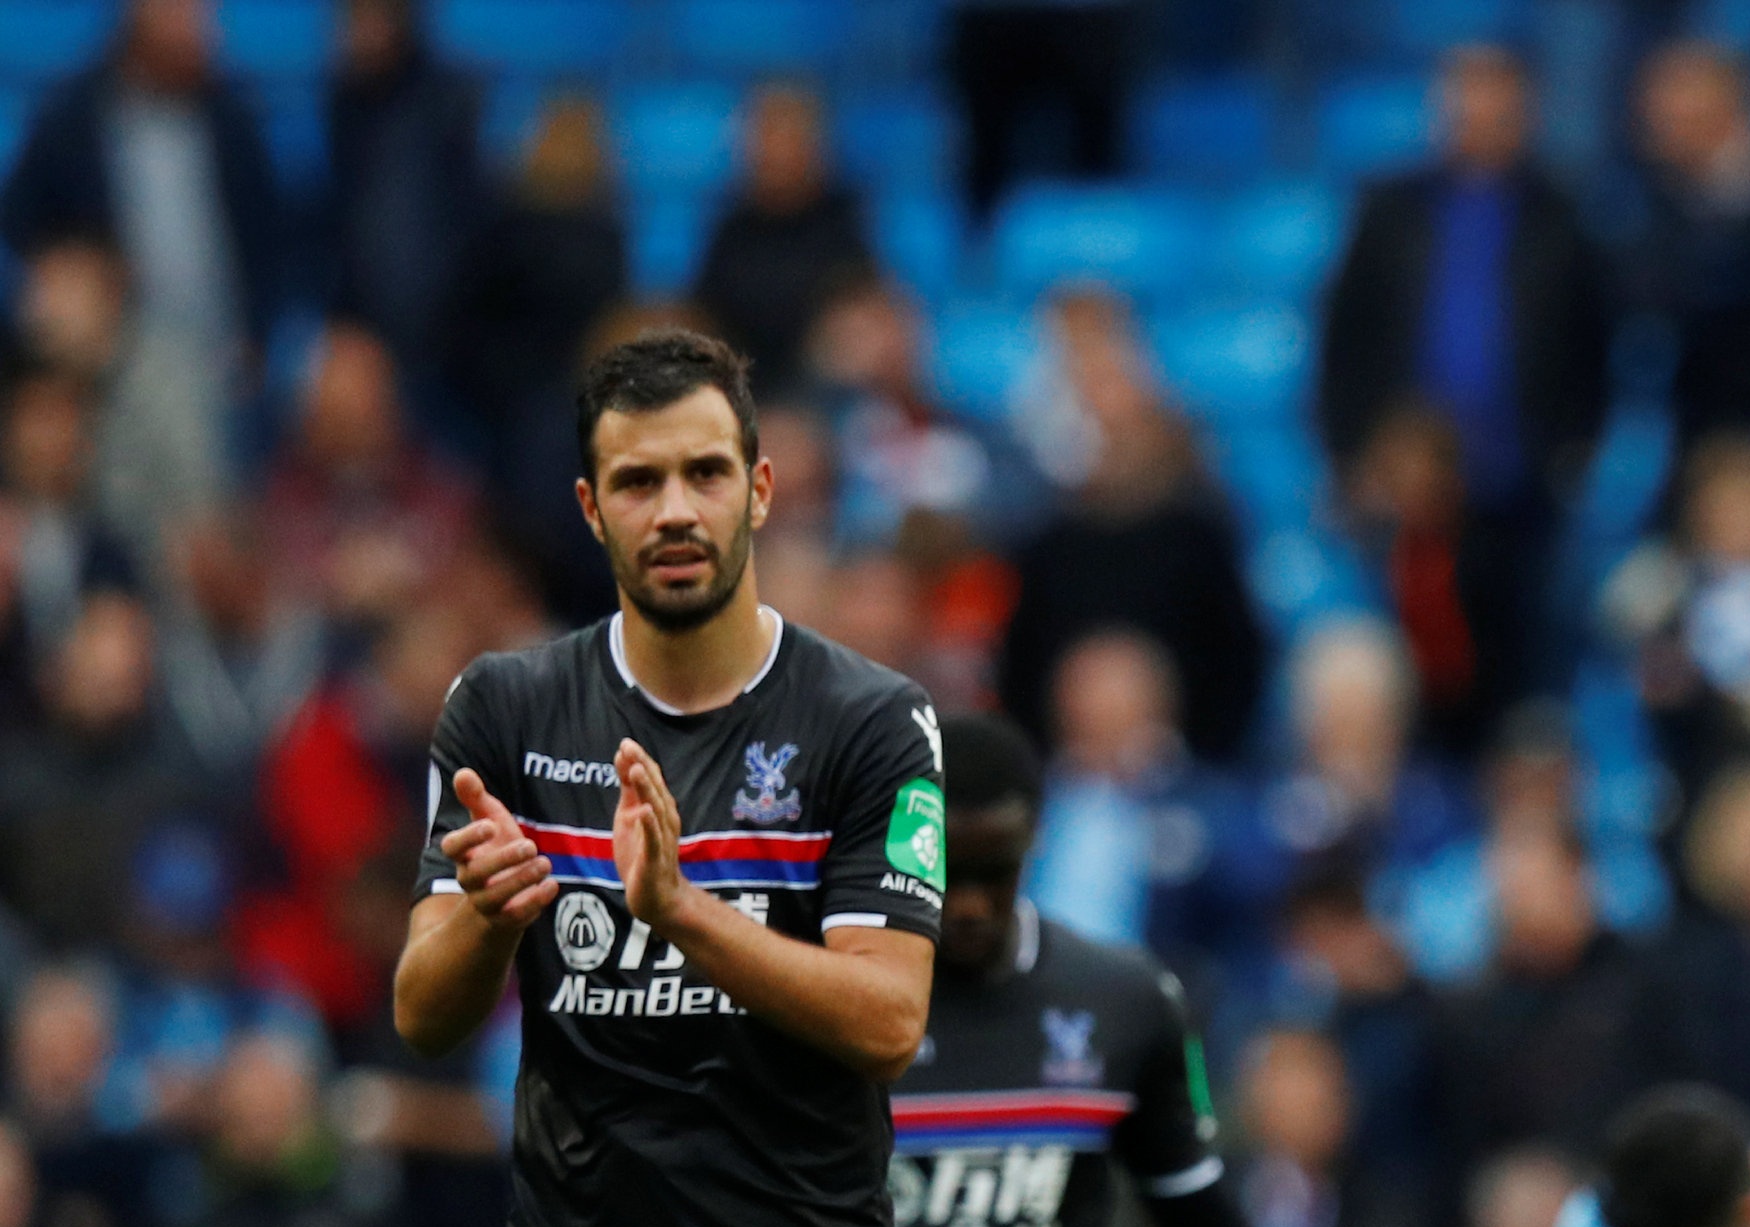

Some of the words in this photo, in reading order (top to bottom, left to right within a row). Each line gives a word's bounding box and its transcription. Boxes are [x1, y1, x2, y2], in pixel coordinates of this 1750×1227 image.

[524, 751, 620, 788] macro
[880, 871, 906, 892] All
[549, 974, 748, 1016] ManBet
